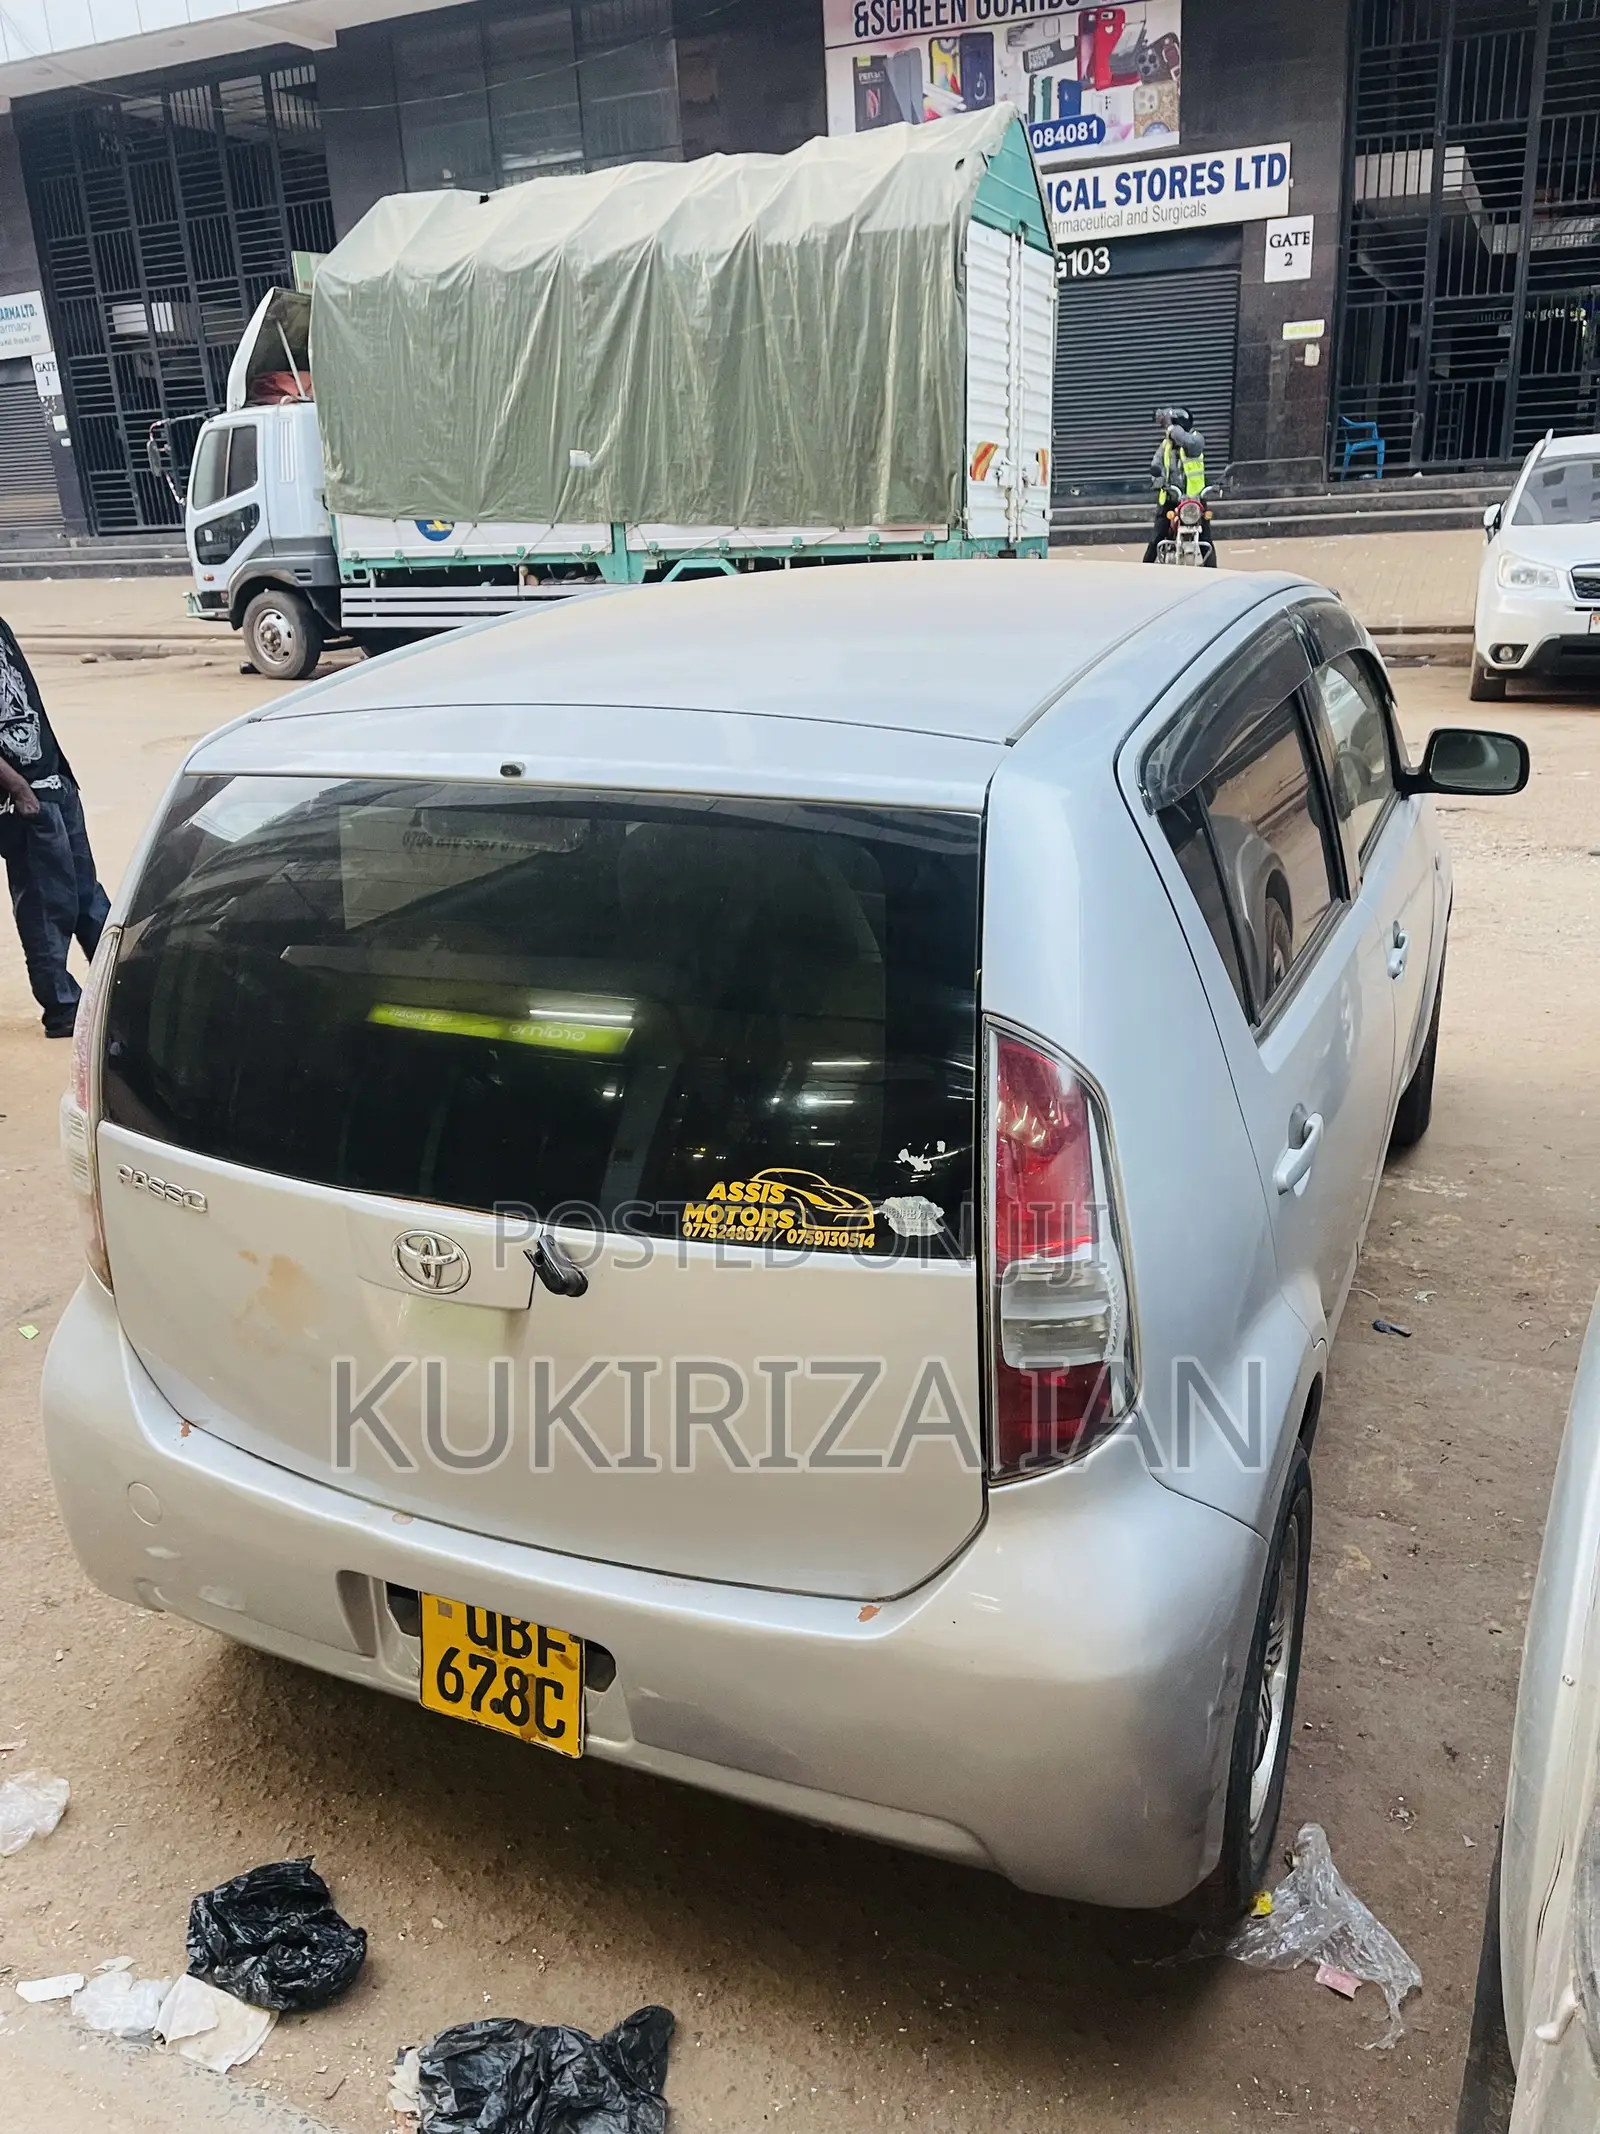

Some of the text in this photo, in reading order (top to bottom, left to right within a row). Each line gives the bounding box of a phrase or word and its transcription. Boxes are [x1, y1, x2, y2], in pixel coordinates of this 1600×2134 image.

[1115, 159, 1225, 206] STORES
[1234, 152, 1287, 191] LTD
[1126, 206, 1148, 225] and
[1152, 200, 1207, 226] Surgicals
[1269, 230, 1311, 249] GATE
[1283, 252, 1293, 267] 2
[34, 361, 57, 373] GATE
[115, 1162, 210, 1214] PASSO
[705, 1180, 788, 1204] ASSIS
[681, 1202, 796, 1230] MOTORS
[681, 1221, 775, 1243] 0775248677
[786, 1229, 876, 1249] 0759130514
[465, 1604, 567, 1668] UBF
